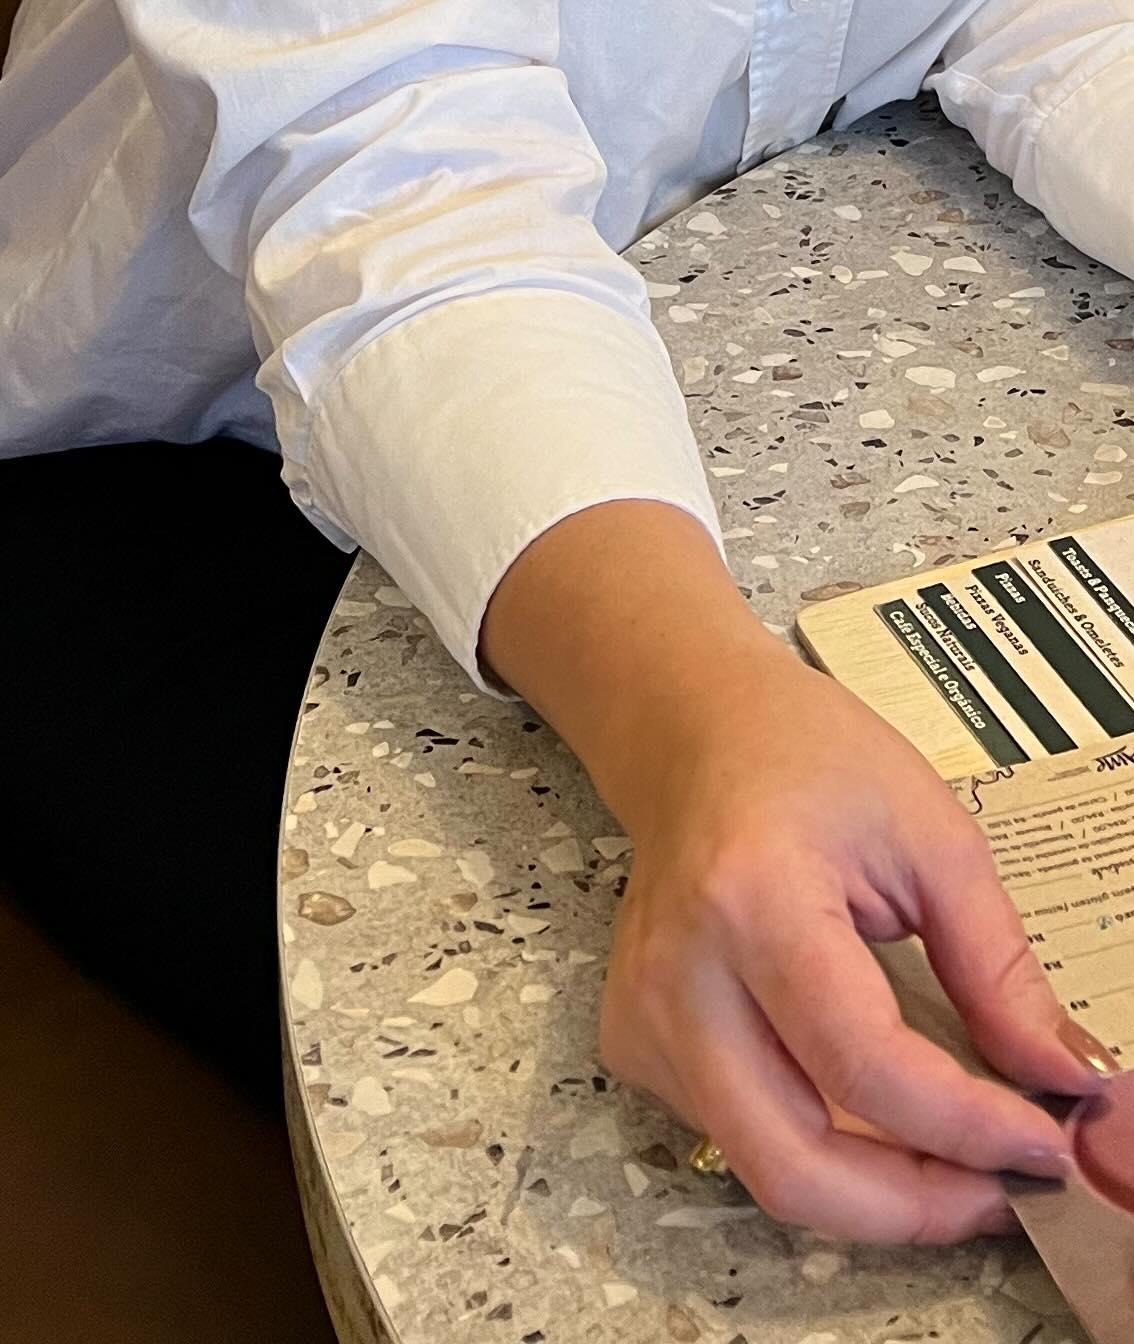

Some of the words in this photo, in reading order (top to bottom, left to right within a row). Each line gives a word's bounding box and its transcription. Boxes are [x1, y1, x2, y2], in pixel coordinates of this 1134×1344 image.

[993, 568, 1028, 607] Pizzas
[1060, 547, 1093, 581] Toasts
[1086, 573, 1101, 588] &
[887, 606, 916, 637] Café
[914, 598, 941, 629] Sucos
[935, 624, 976, 671] Naturais
[963, 583, 995, 615] Pizzas
[990, 613, 1029, 655] Veganas
[1073, 613, 1087, 622] &
[904, 631, 948, 675] Especial
[1079, 621, 1124, 668] Omeletes
[936, 671, 949, 683] e
[939, 676, 990, 734] Orgânico
